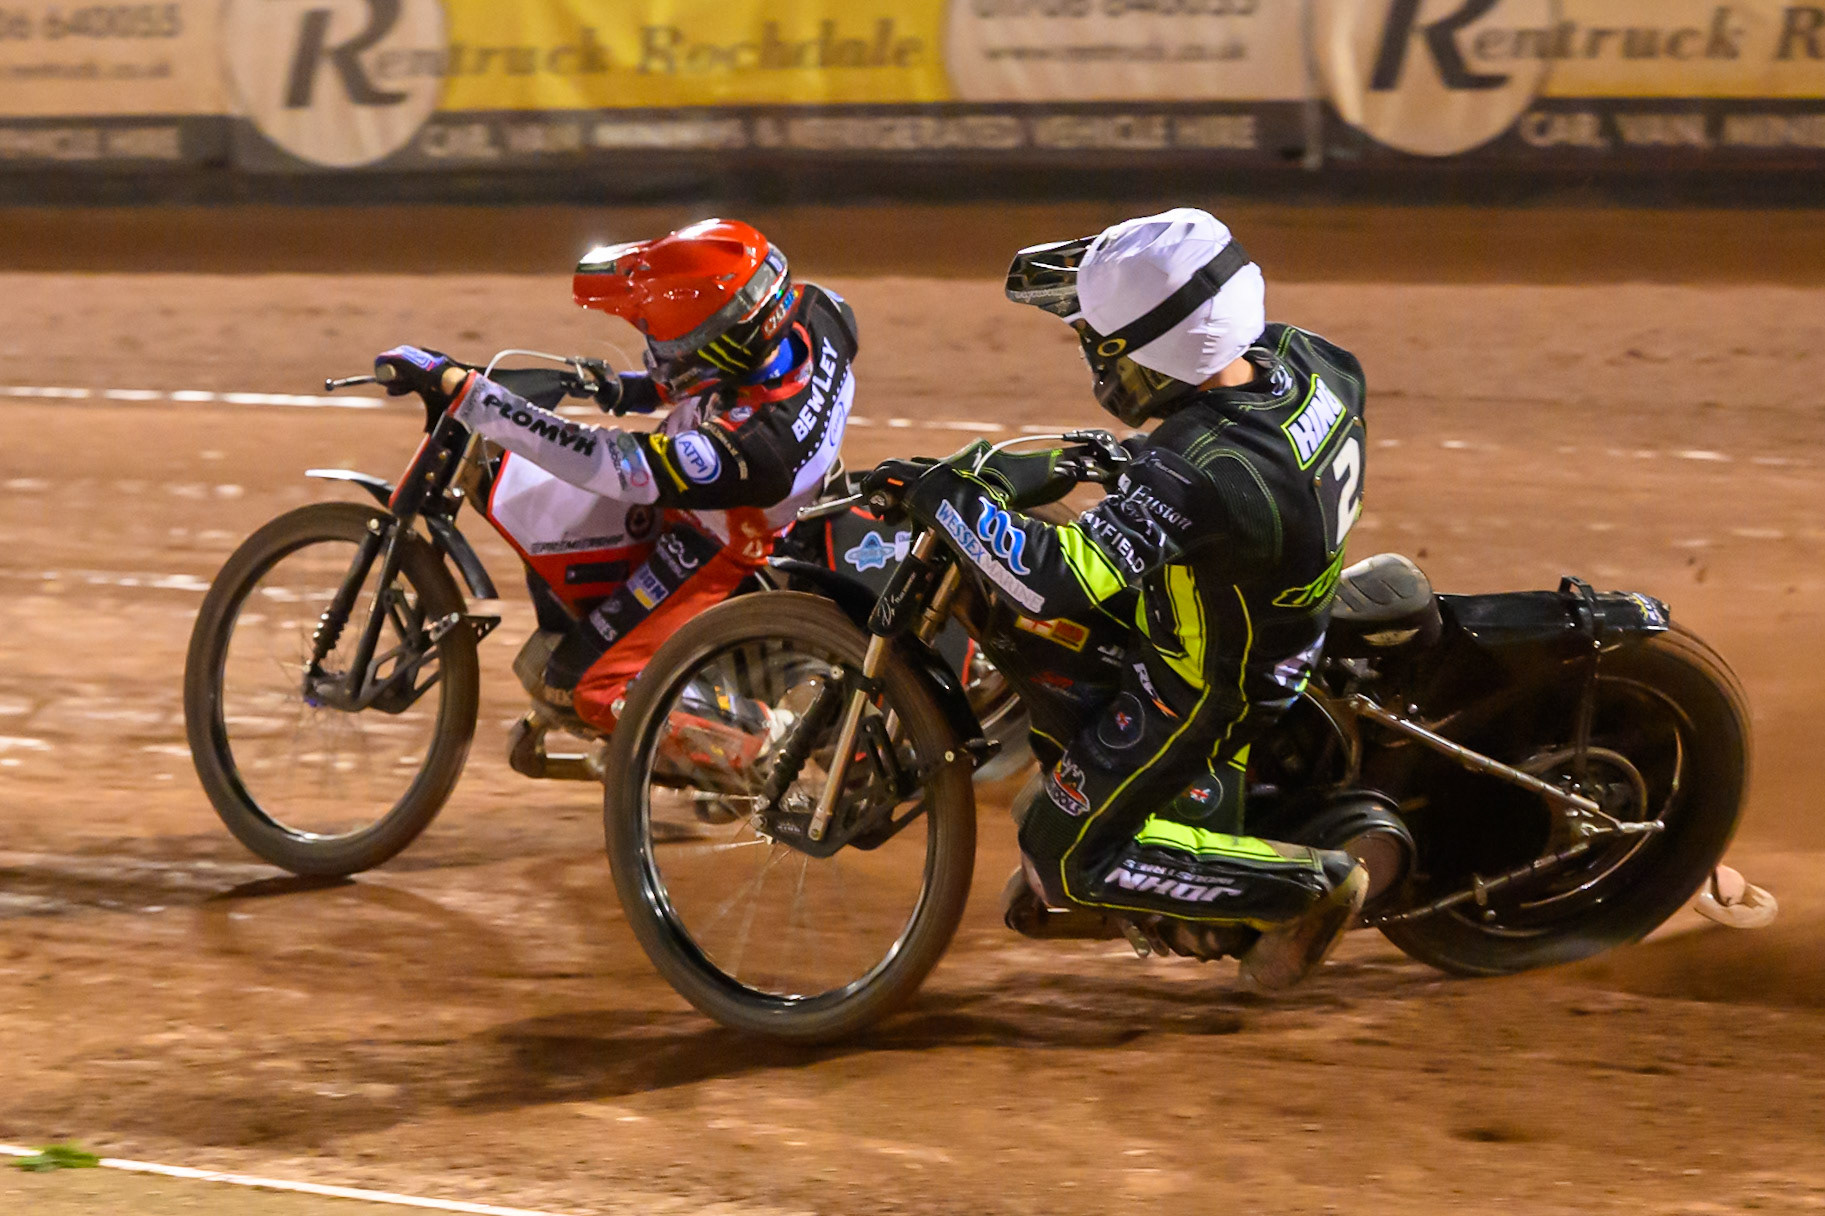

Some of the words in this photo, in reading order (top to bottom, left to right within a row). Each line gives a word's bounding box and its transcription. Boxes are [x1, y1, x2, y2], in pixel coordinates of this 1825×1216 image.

[791, 336, 839, 443] BEWLEY
[938, 503, 986, 563] WESSEX
[1332, 437, 1360, 546] 2
